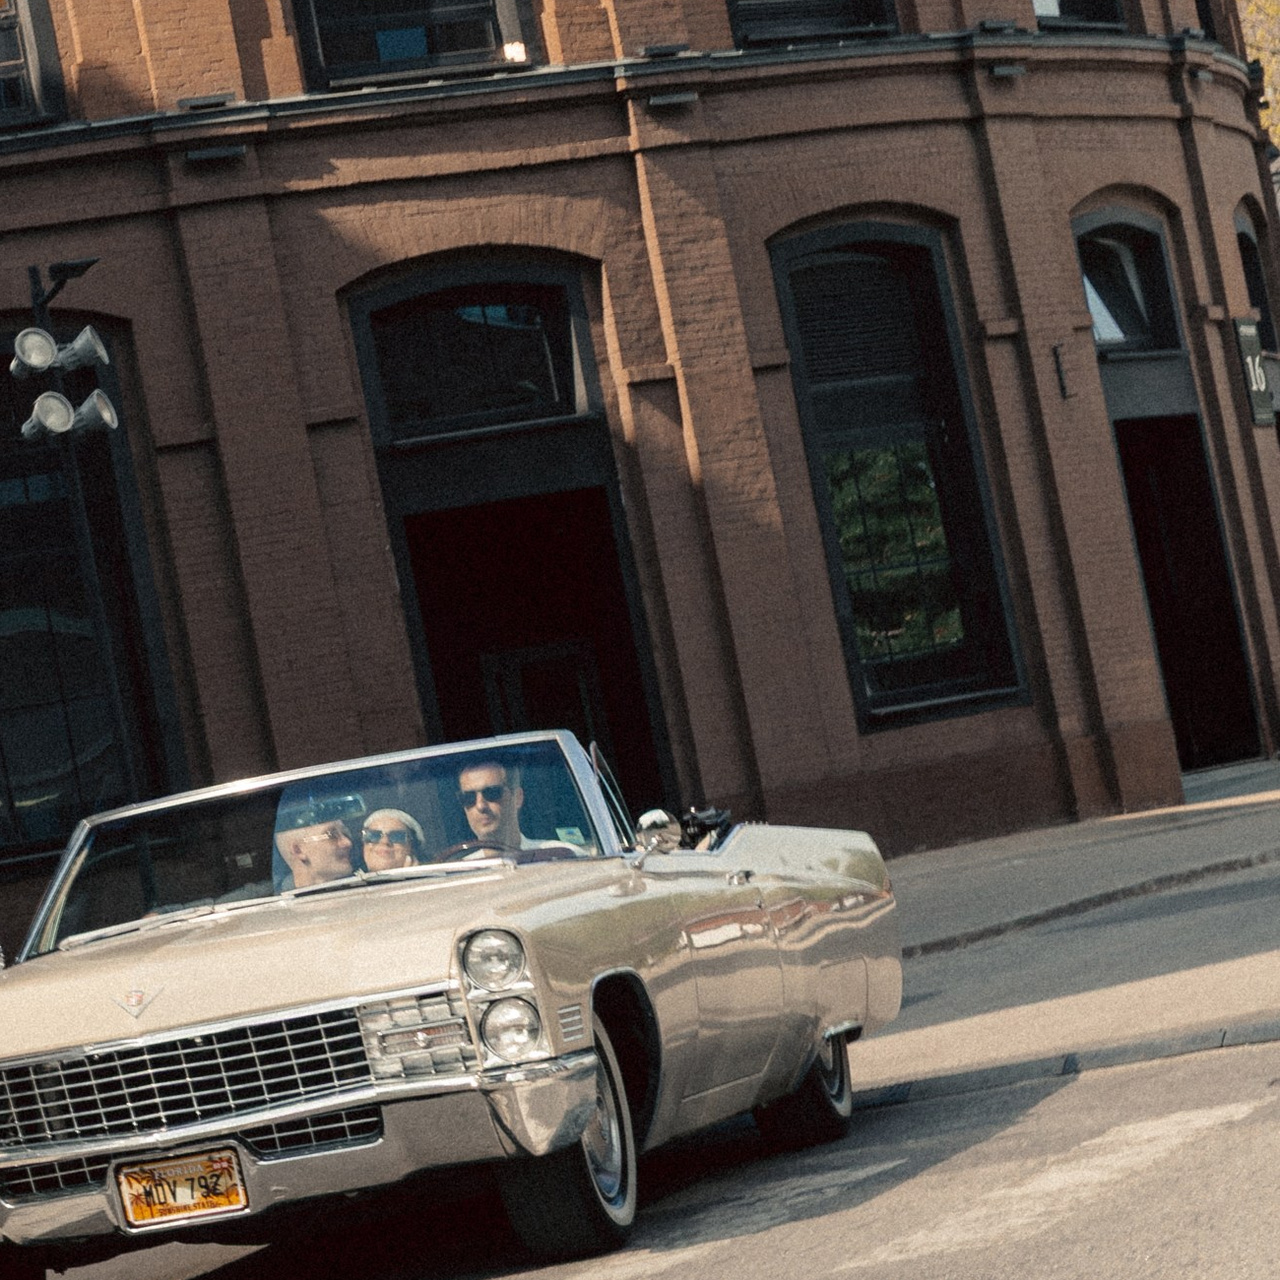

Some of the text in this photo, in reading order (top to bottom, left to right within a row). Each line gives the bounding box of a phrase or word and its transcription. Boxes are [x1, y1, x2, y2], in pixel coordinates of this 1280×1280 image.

[1245, 355, 1266, 391] 16
[155, 1164, 204, 1178] FLORIDA
[185, 1173, 224, 1199] 792
